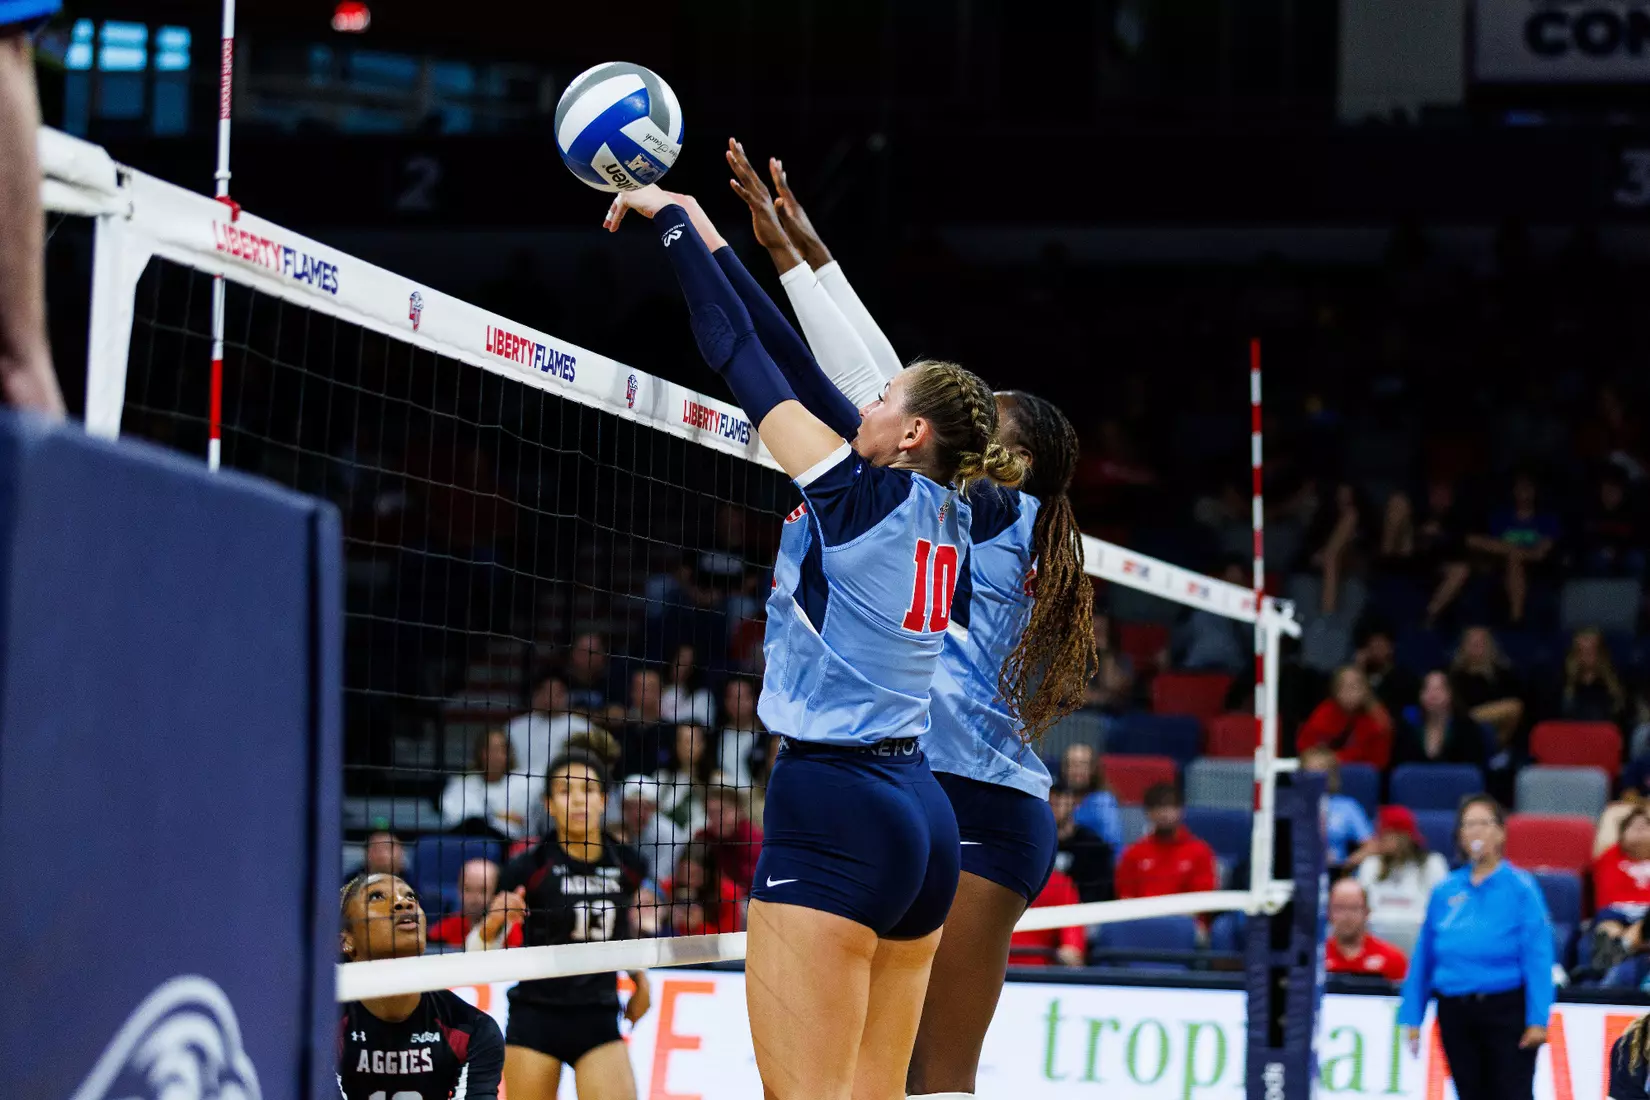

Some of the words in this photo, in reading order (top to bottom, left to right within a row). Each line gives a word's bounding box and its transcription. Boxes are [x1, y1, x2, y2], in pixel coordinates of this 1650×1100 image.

[643, 132, 669, 154] Touch
[395, 156, 441, 211] 2
[605, 162, 642, 192] olten
[901, 537, 959, 633] 10
[570, 898, 616, 940] 13
[355, 1046, 434, 1075] AGGIES
